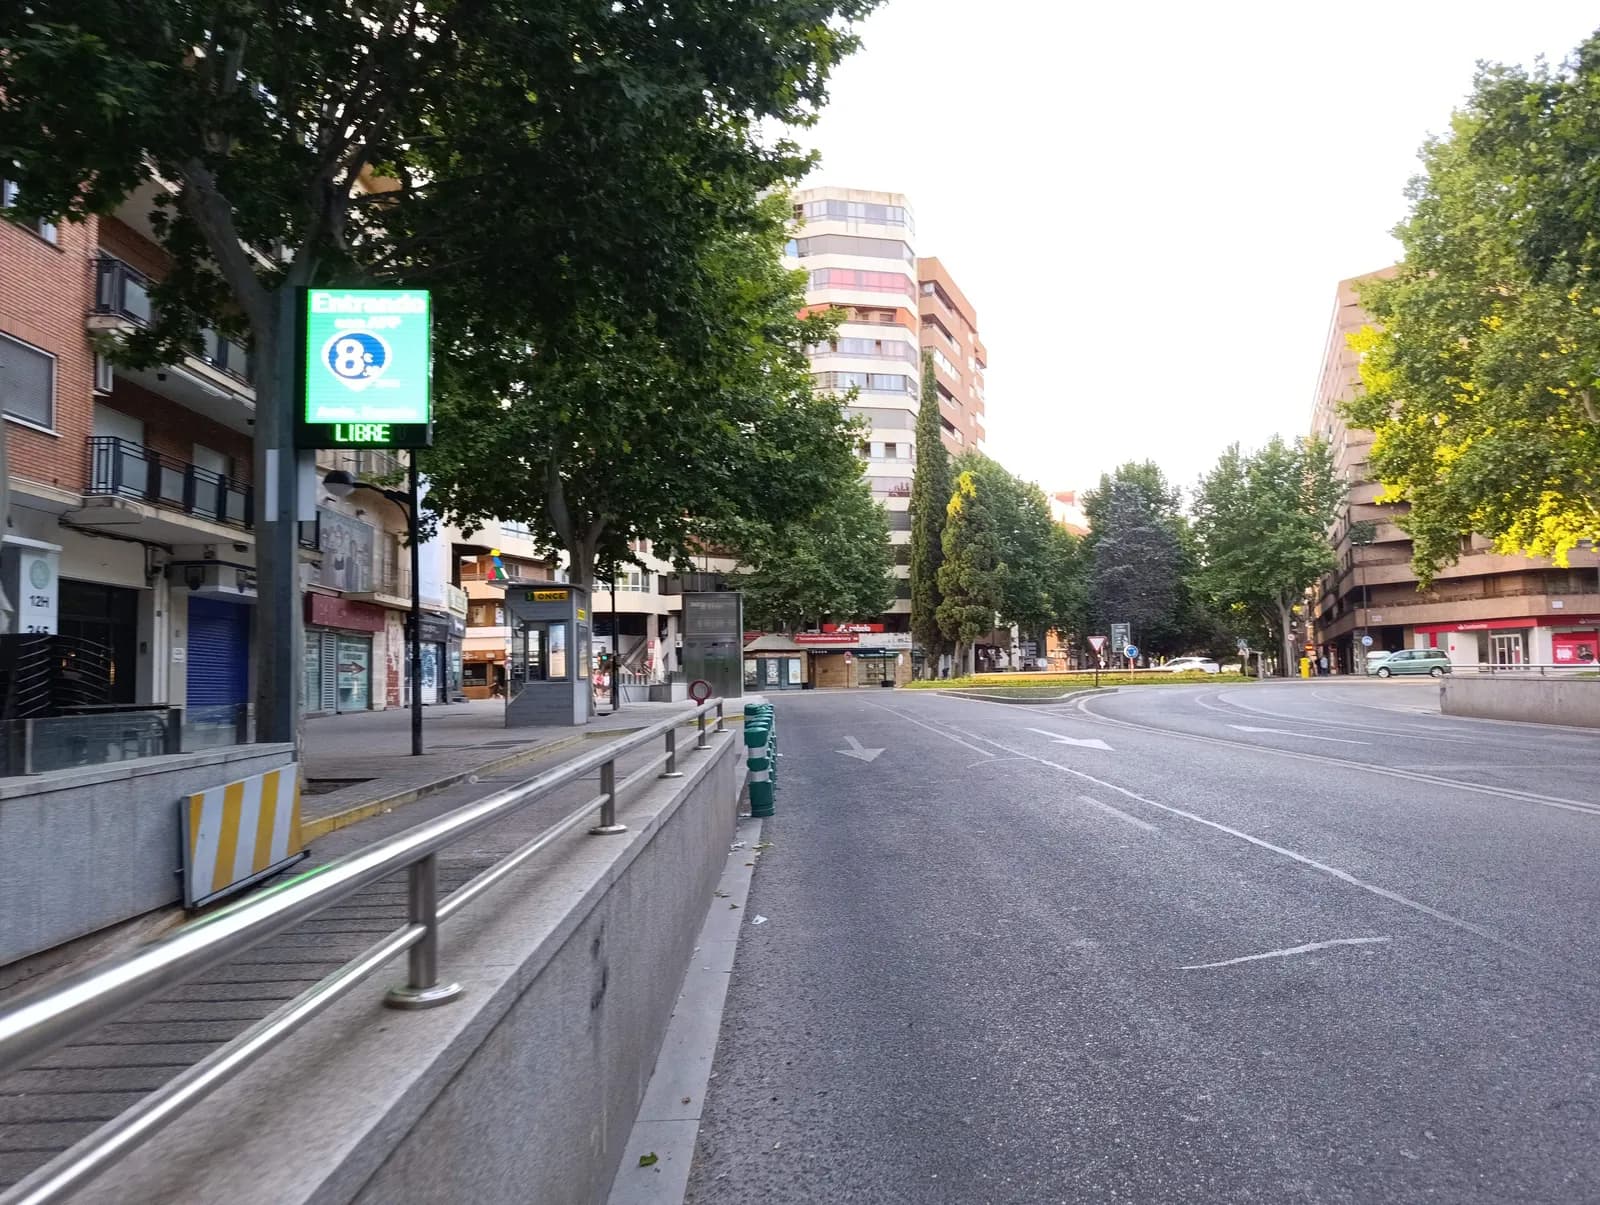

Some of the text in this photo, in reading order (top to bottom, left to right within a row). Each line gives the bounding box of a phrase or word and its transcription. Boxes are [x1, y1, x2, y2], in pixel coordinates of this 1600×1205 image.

[335, 424, 390, 442] LIBRE
[29, 595, 50, 608] 12H
[537, 592, 565, 600] ONCE
